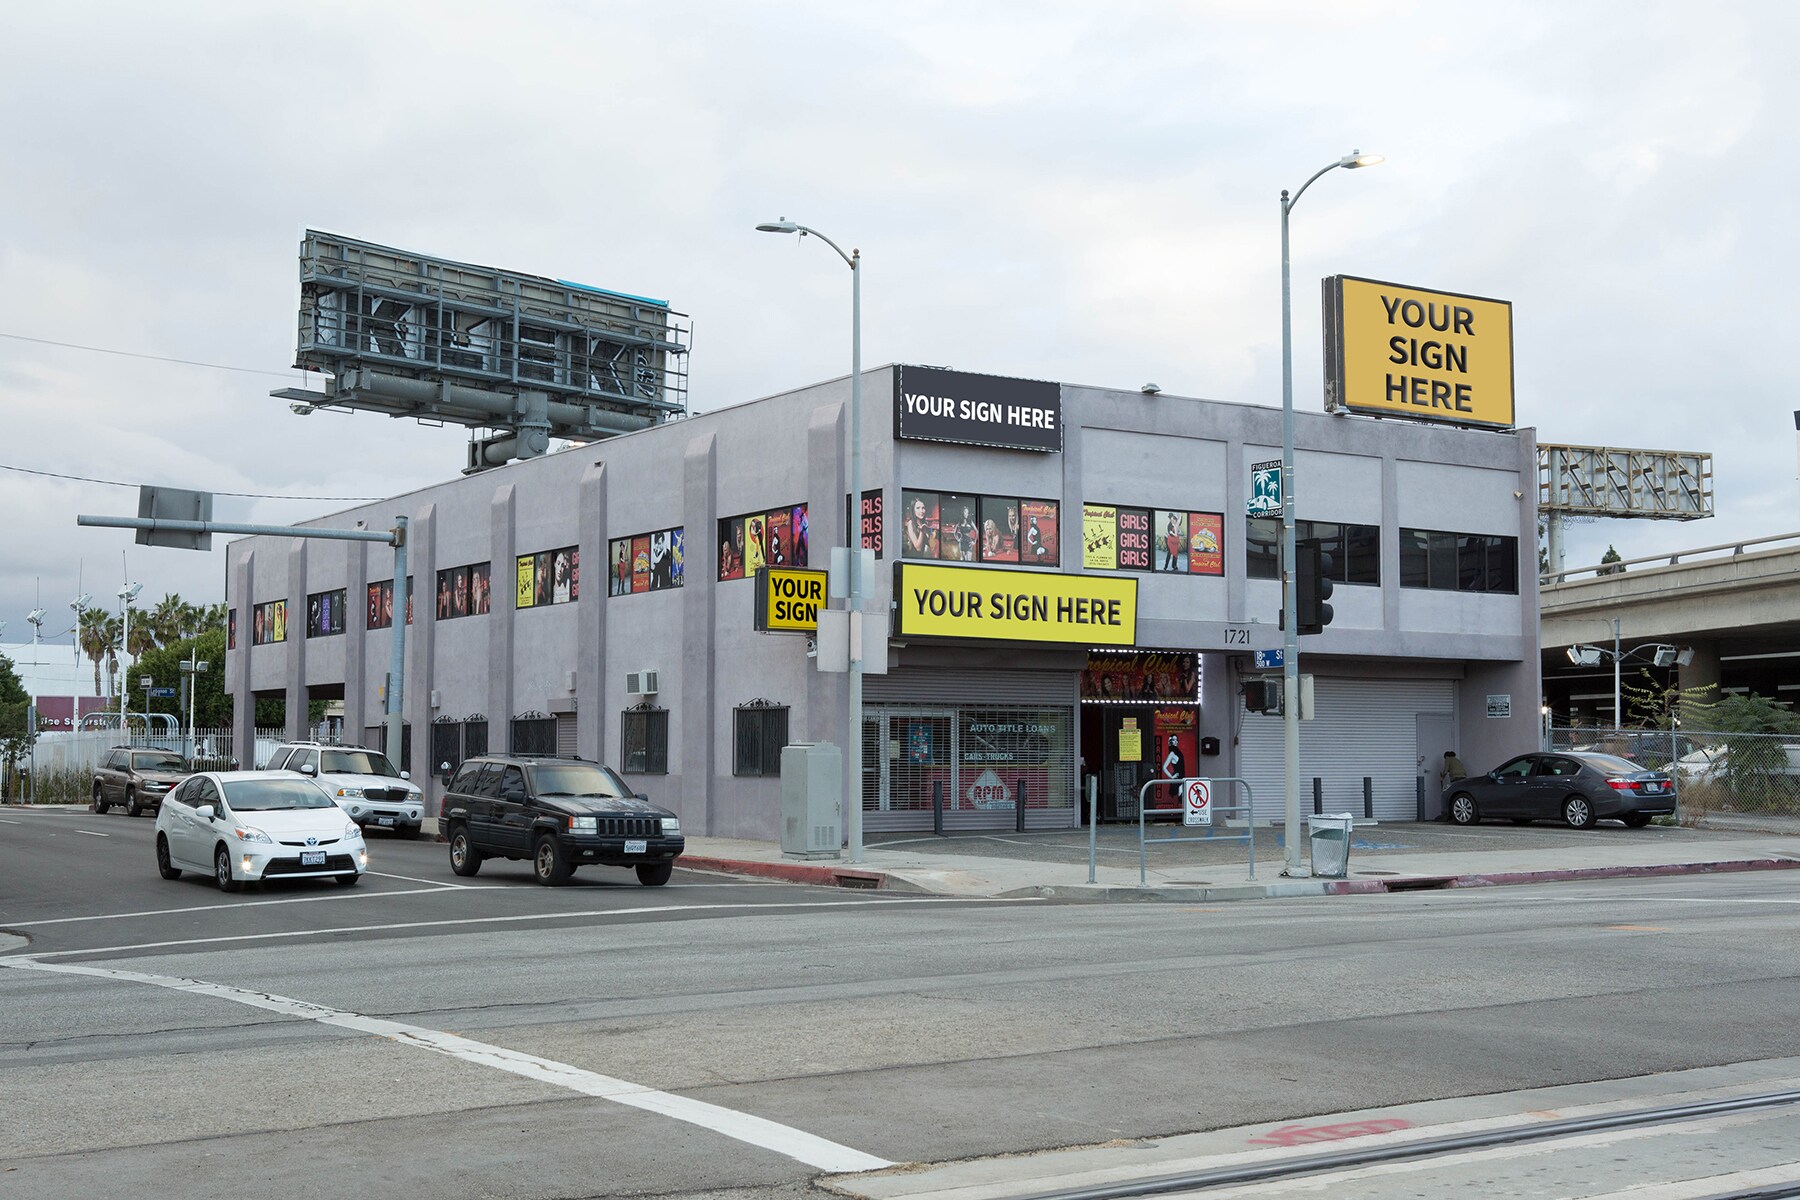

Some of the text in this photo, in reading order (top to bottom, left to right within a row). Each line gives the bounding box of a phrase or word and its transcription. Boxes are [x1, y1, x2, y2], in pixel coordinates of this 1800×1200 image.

[1380, 295, 1475, 336] YOUR
[1388, 336, 1468, 373] SIGN
[1386, 373, 1473, 413] HERE
[905, 393, 1055, 430] YOUR SIGN HERE
[1252, 461, 1281, 470] FIGUEROA
[1252, 509, 1283, 518] CORRIDOR
[1120, 514, 1148, 530] GIRLS
[1120, 532, 1148, 549] GIRLS
[1120, 550, 1148, 566] GIRLS
[772, 577, 821, 600] YOUR
[775, 600, 817, 622] SIGN
[914, 588, 1121, 626] YOUR SIGN HERE
[1224, 629, 1250, 644] 1721
[1275, 650, 1283, 660] St
[1087, 653, 1179, 675] ropical Club
[1256, 660, 1265, 668] 500
[1154, 709, 1194, 721] Tropical Club
[970, 724, 1056, 733] AUTO TITLE LOANS
[973, 786, 1004, 800] RPM
